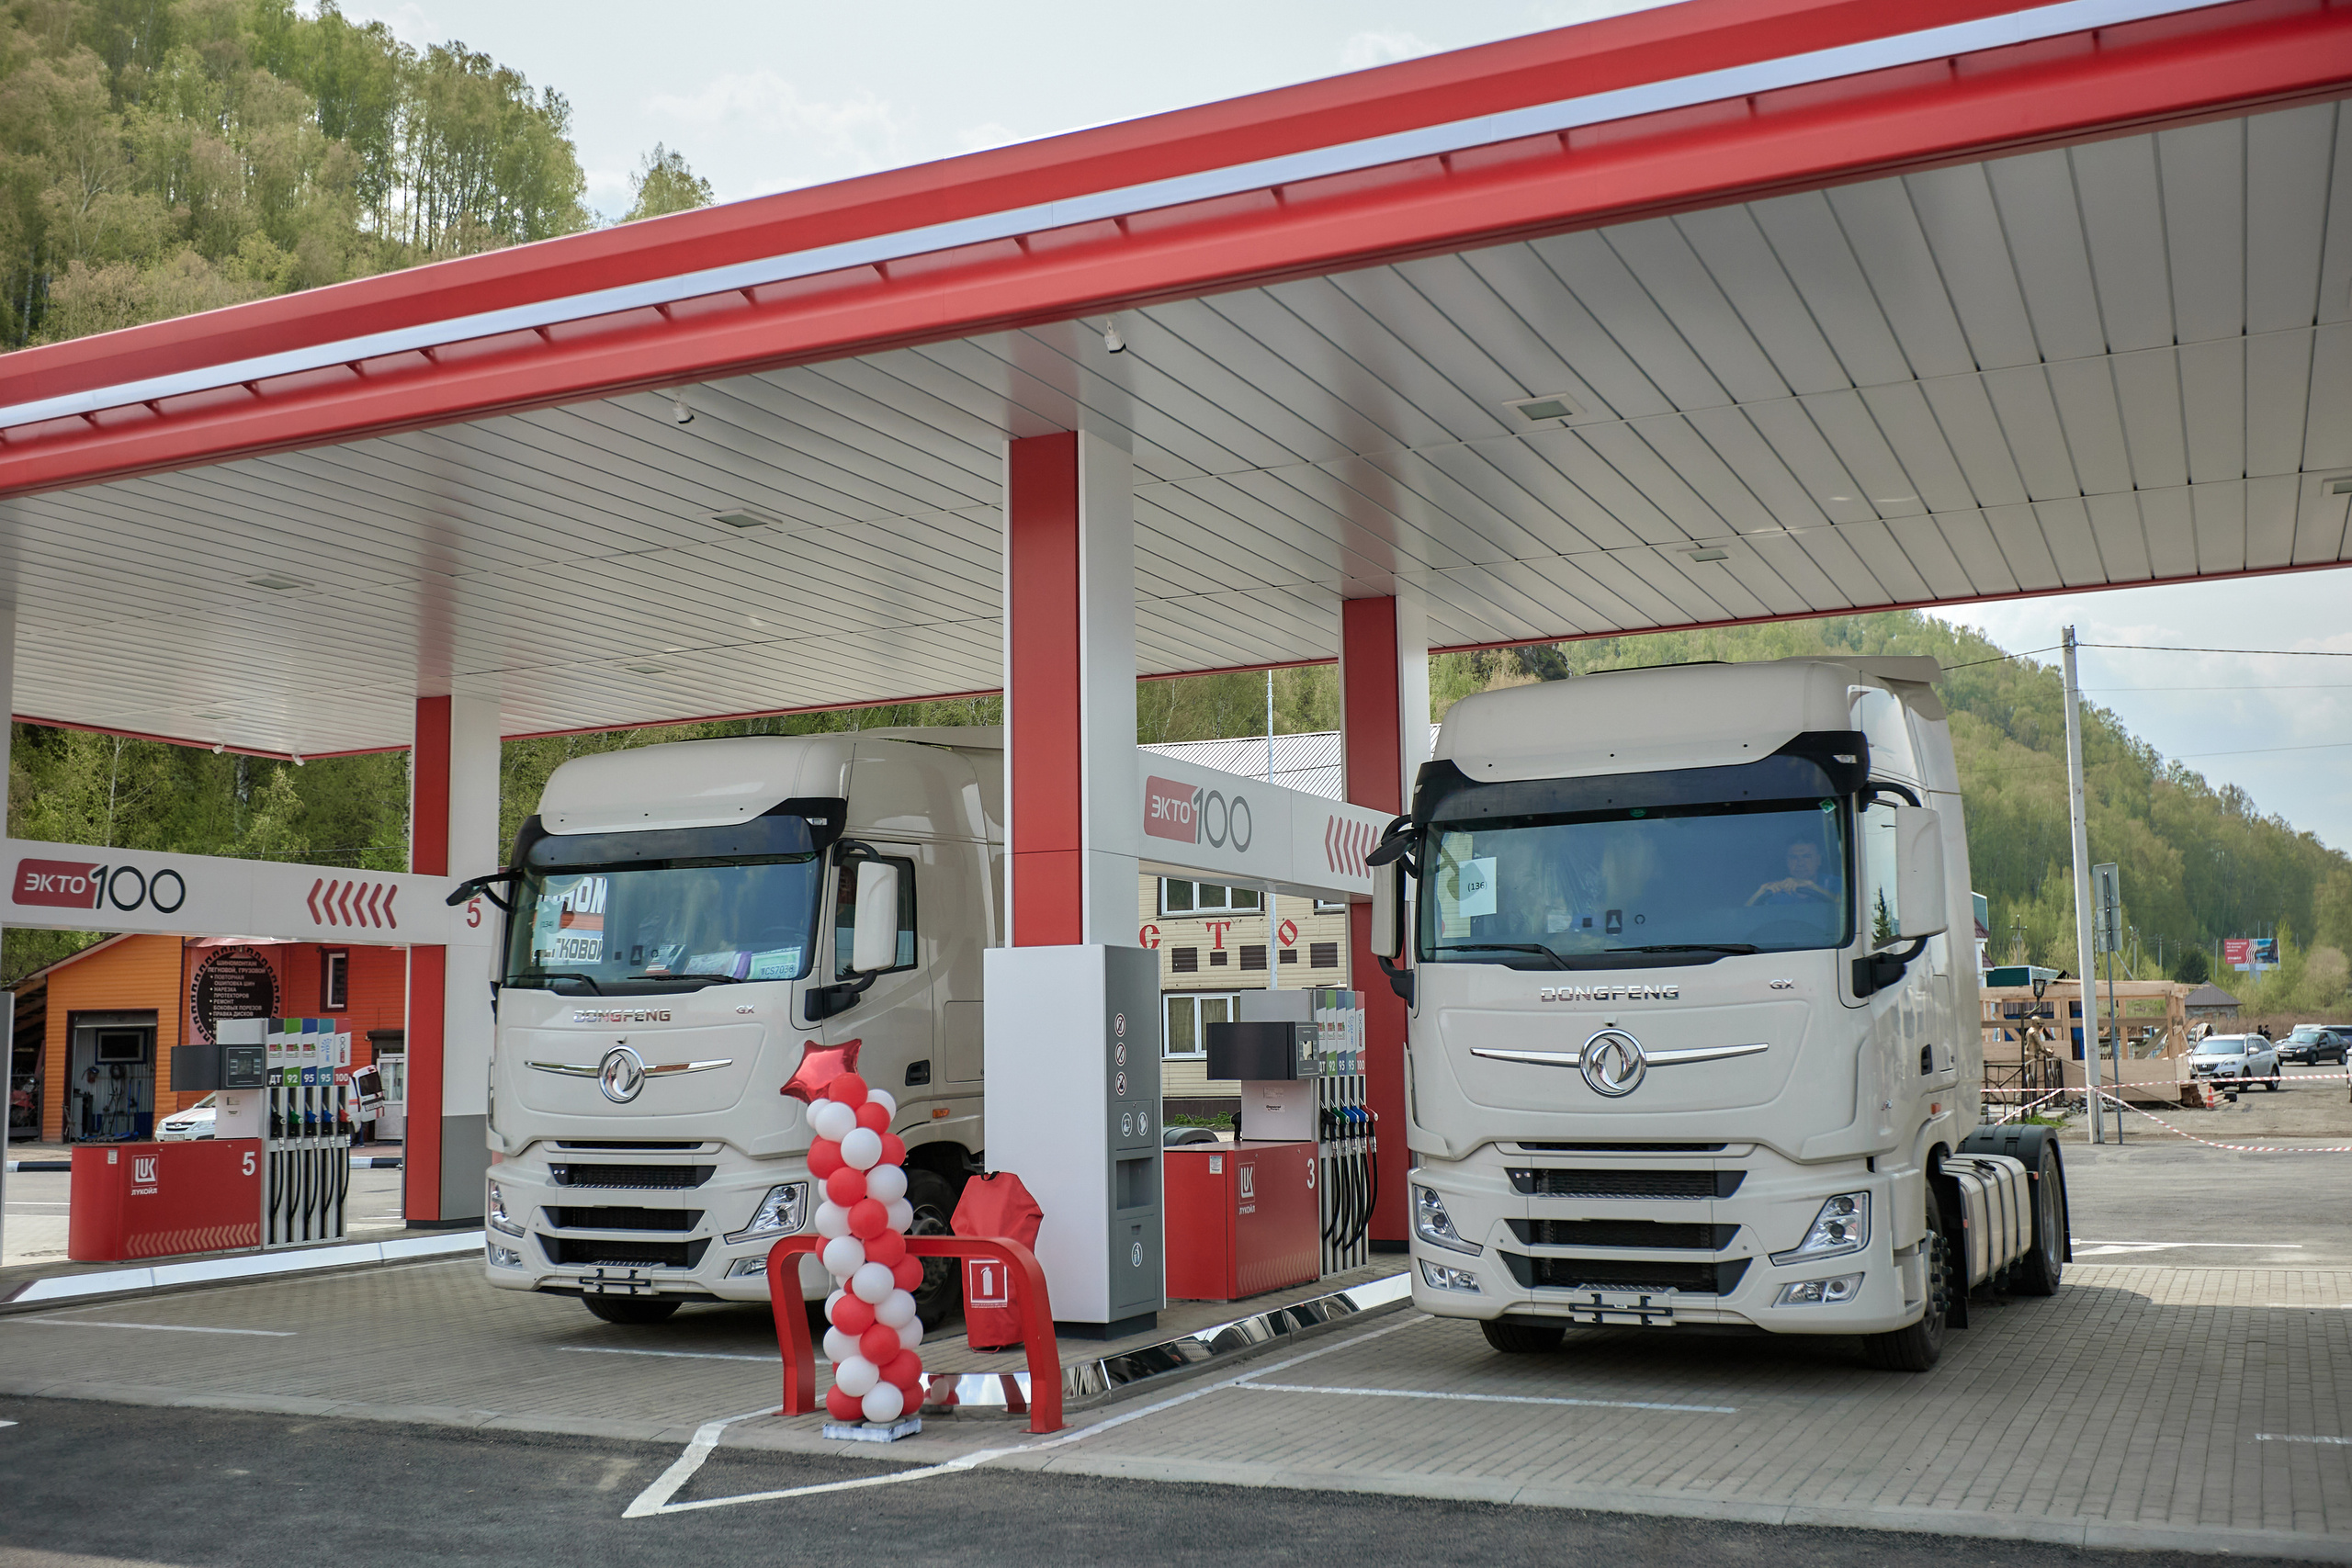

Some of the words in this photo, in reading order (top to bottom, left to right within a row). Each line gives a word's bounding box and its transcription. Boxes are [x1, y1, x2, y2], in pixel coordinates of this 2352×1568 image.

[1150, 795, 1191, 824] ЭКТО
[1193, 787, 1252, 853] 100
[24, 873, 86, 894] ЭКТО
[91, 864, 187, 914] 100
[467, 897, 481, 928] 5
[1769, 978, 1794, 990] GX
[1541, 985, 1679, 1002] DONGFENG
[573, 1009, 671, 1023] DONGFENG
[736, 1005, 755, 1015] GX
[1329, 1060, 1336, 1072] 92
[1339, 1059, 1346, 1071] 95
[1348, 1059, 1355, 1071] 95
[1356, 1060, 1365, 1071] 100
[268, 1074, 282, 1085] ДТ
[287, 1074, 299, 1083] 92
[303, 1074, 315, 1083] 95
[320, 1073, 332, 1083] 95
[334, 1073, 349, 1082] 100
[242, 1151, 256, 1177] 5
[1306, 1157, 1316, 1190] 3
[131, 1187, 158, 1196] ЛУКОЙЛ
[1238, 1203, 1256, 1215] ЛУКОЙЛ
